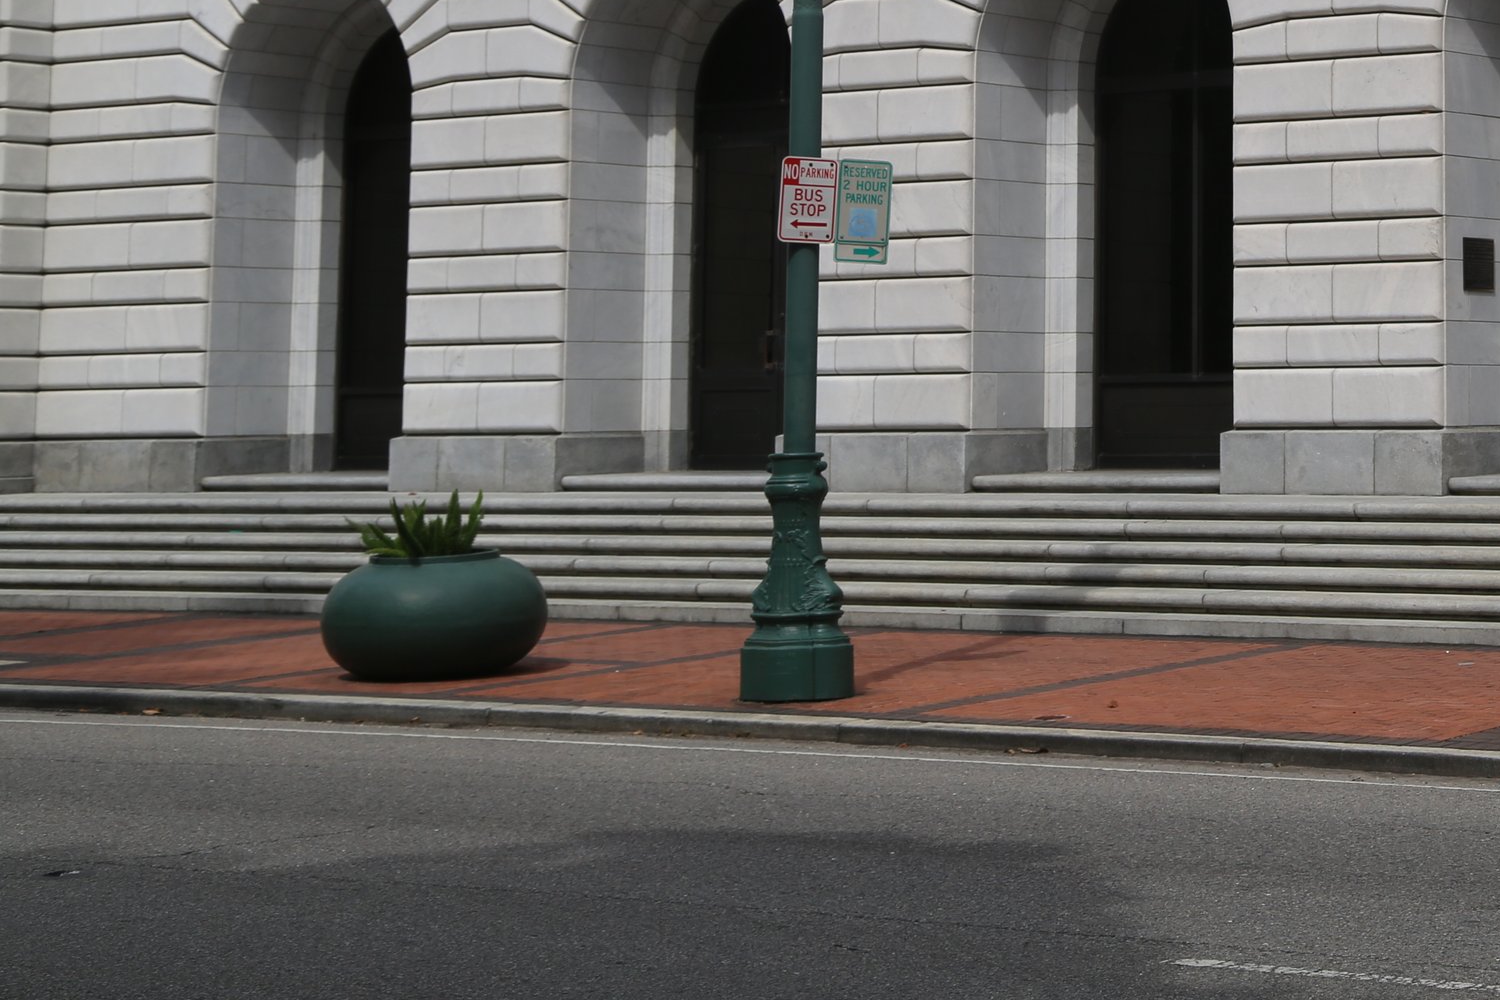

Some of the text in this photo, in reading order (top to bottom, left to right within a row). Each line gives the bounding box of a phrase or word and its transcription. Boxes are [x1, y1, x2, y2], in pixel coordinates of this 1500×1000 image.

[783, 163, 835, 180] NO PARKING
[843, 167, 888, 179] RESERVED
[843, 180, 887, 192] 2 HOUR
[794, 188, 823, 202] BUS
[845, 193, 883, 205] PARKING
[790, 203, 826, 217] STOP
